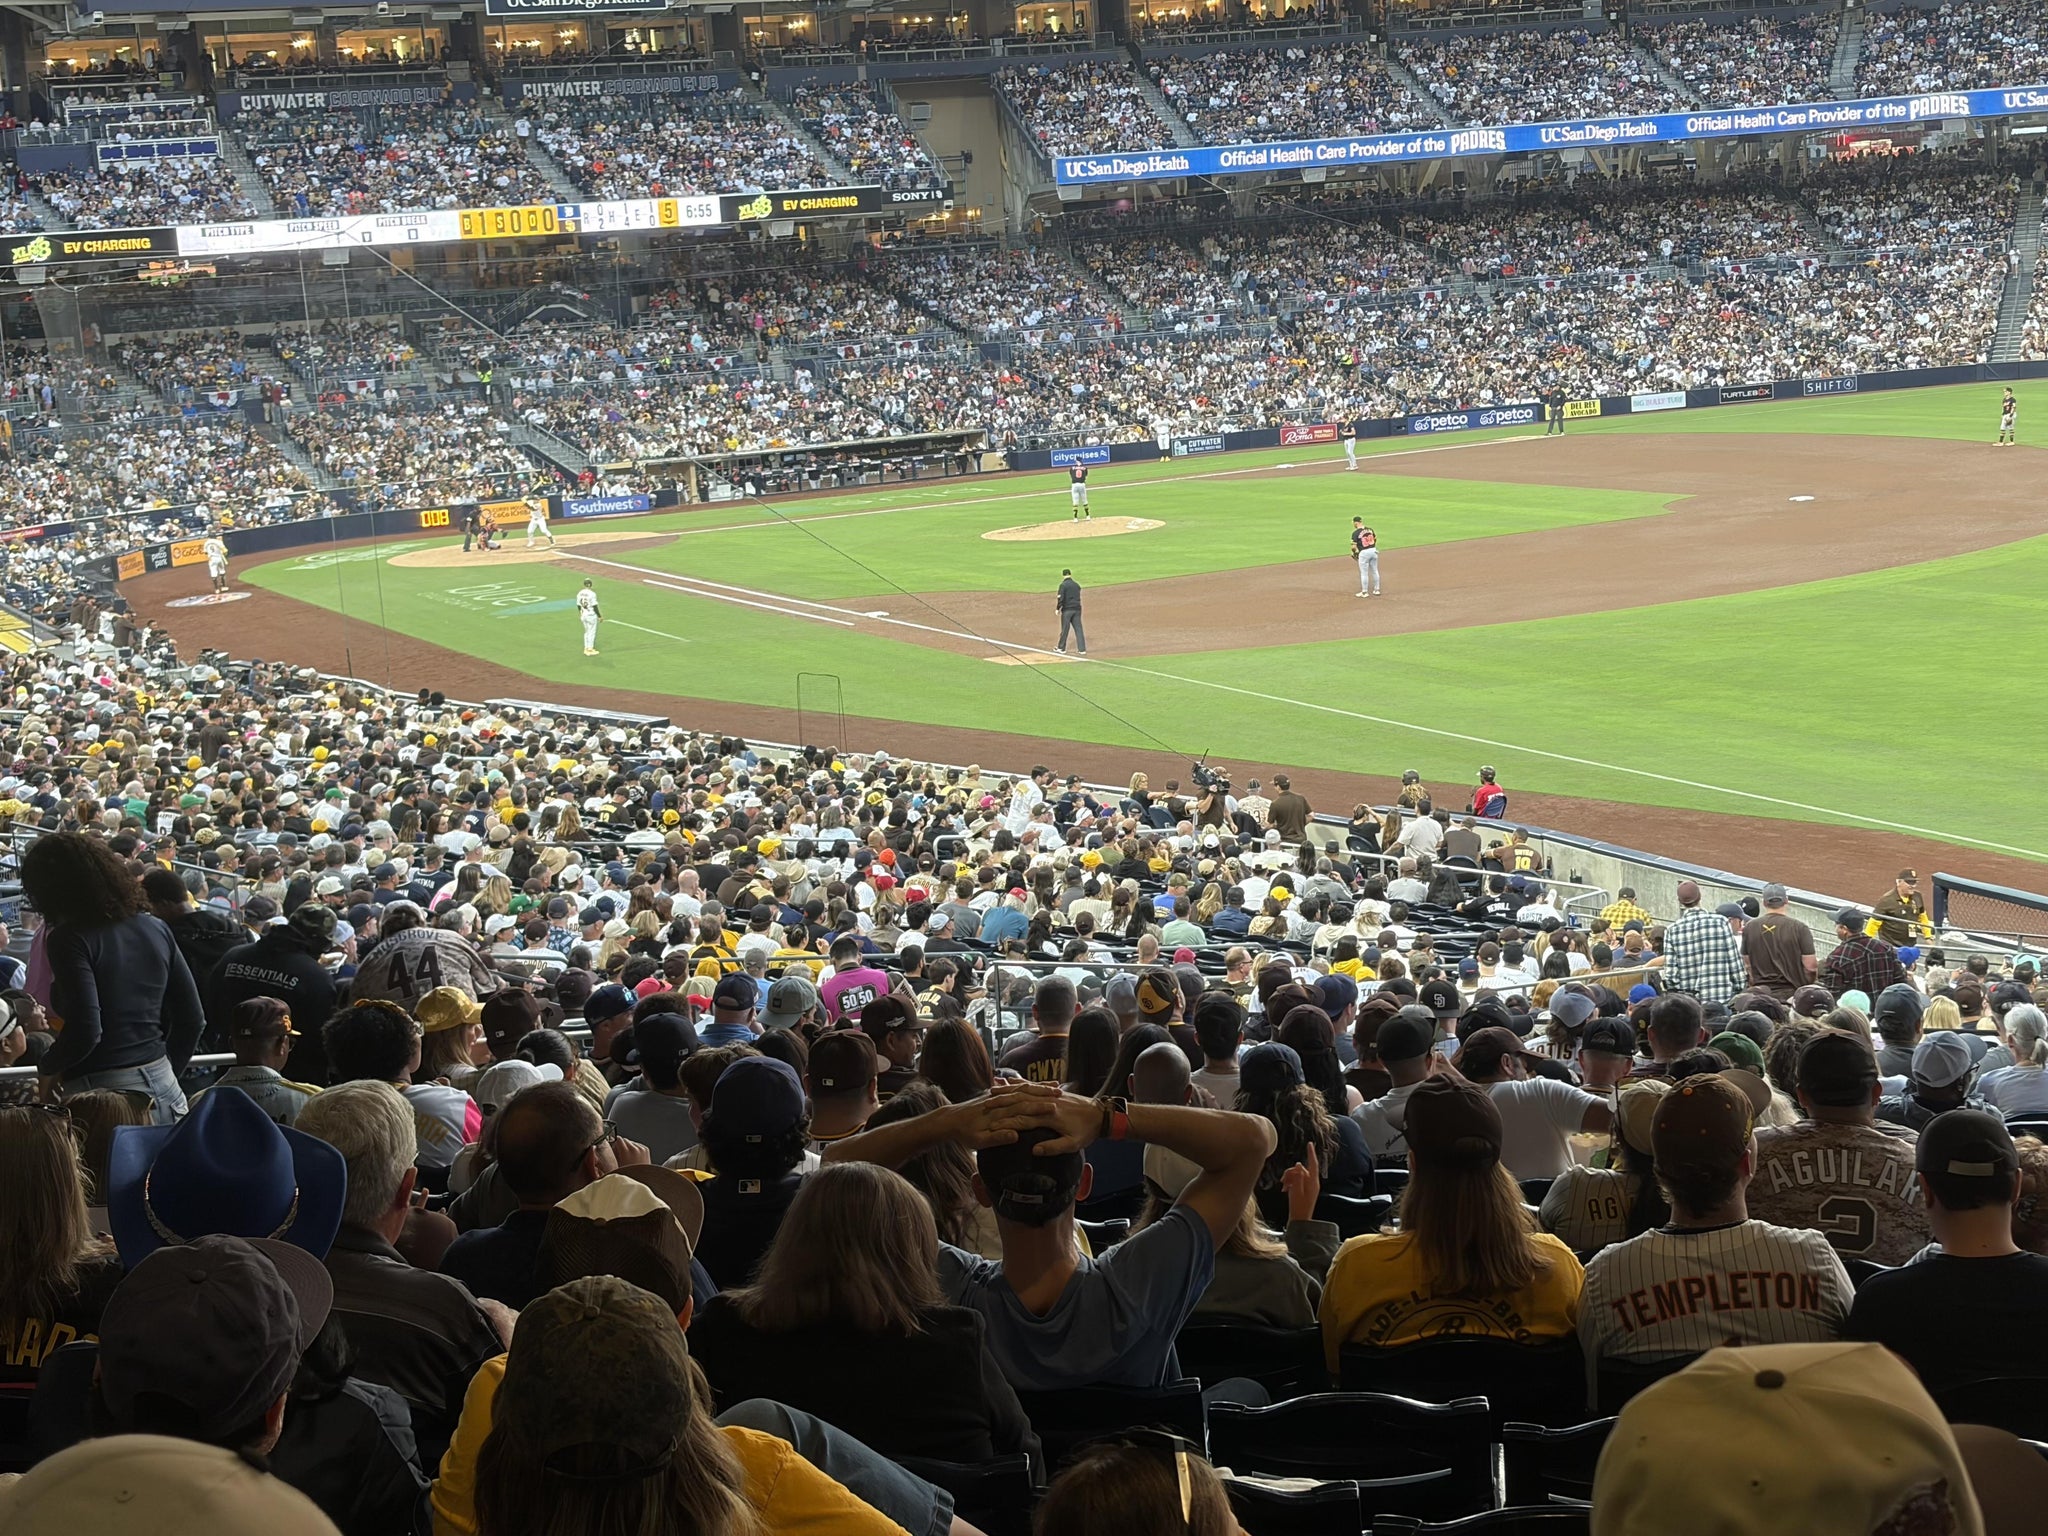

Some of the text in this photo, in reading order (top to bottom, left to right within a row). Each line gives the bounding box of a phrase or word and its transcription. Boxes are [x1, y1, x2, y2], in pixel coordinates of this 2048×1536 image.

[523, 80, 601, 97] CUTWATER
[604, 77, 682, 95] CORONADO
[240, 93, 325, 111] CUTWATER
[329, 88, 411, 107] CORONADO
[2004, 93, 2028, 109] UC
[1686, 95, 1971, 133] Official Health Care Provider of the PADRES
[1540, 121, 1658, 144] UC San Diego Health
[1220, 131, 1507, 168] Official Health Care Provider of the PADRES
[1065, 154, 1190, 178] UC San Diego Health
[782, 196, 858, 211] EV CHARGING
[892, 191, 928, 202] SONY
[583, 208, 642, 225] R H E
[663, 202, 673, 219] 5
[685, 203, 713, 219] 6:55
[478, 211, 488, 236] 1
[64, 237, 151, 255] EV CHARGING
[1722, 387, 1770, 399] TURTLEBOX
[1806, 380, 1842, 393] SHIFT
[1570, 400, 1597, 410] DEL REY
[1570, 408, 1598, 417] AVOCADO
[1430, 414, 1468, 430] petco
[1496, 408, 1534, 425] petco
[1188, 437, 1222, 448] CUTWATER
[1285, 431, 1313, 445] Roma
[570, 499, 634, 516] Southwest
[371, 927, 443, 960] MUSGROVE
[228, 962, 299, 988] ESSENTIALS
[387, 945, 444, 999] 44
[1434, 993, 1446, 1008] SD
[1611, 1270, 1821, 1333] TEMPLETON
